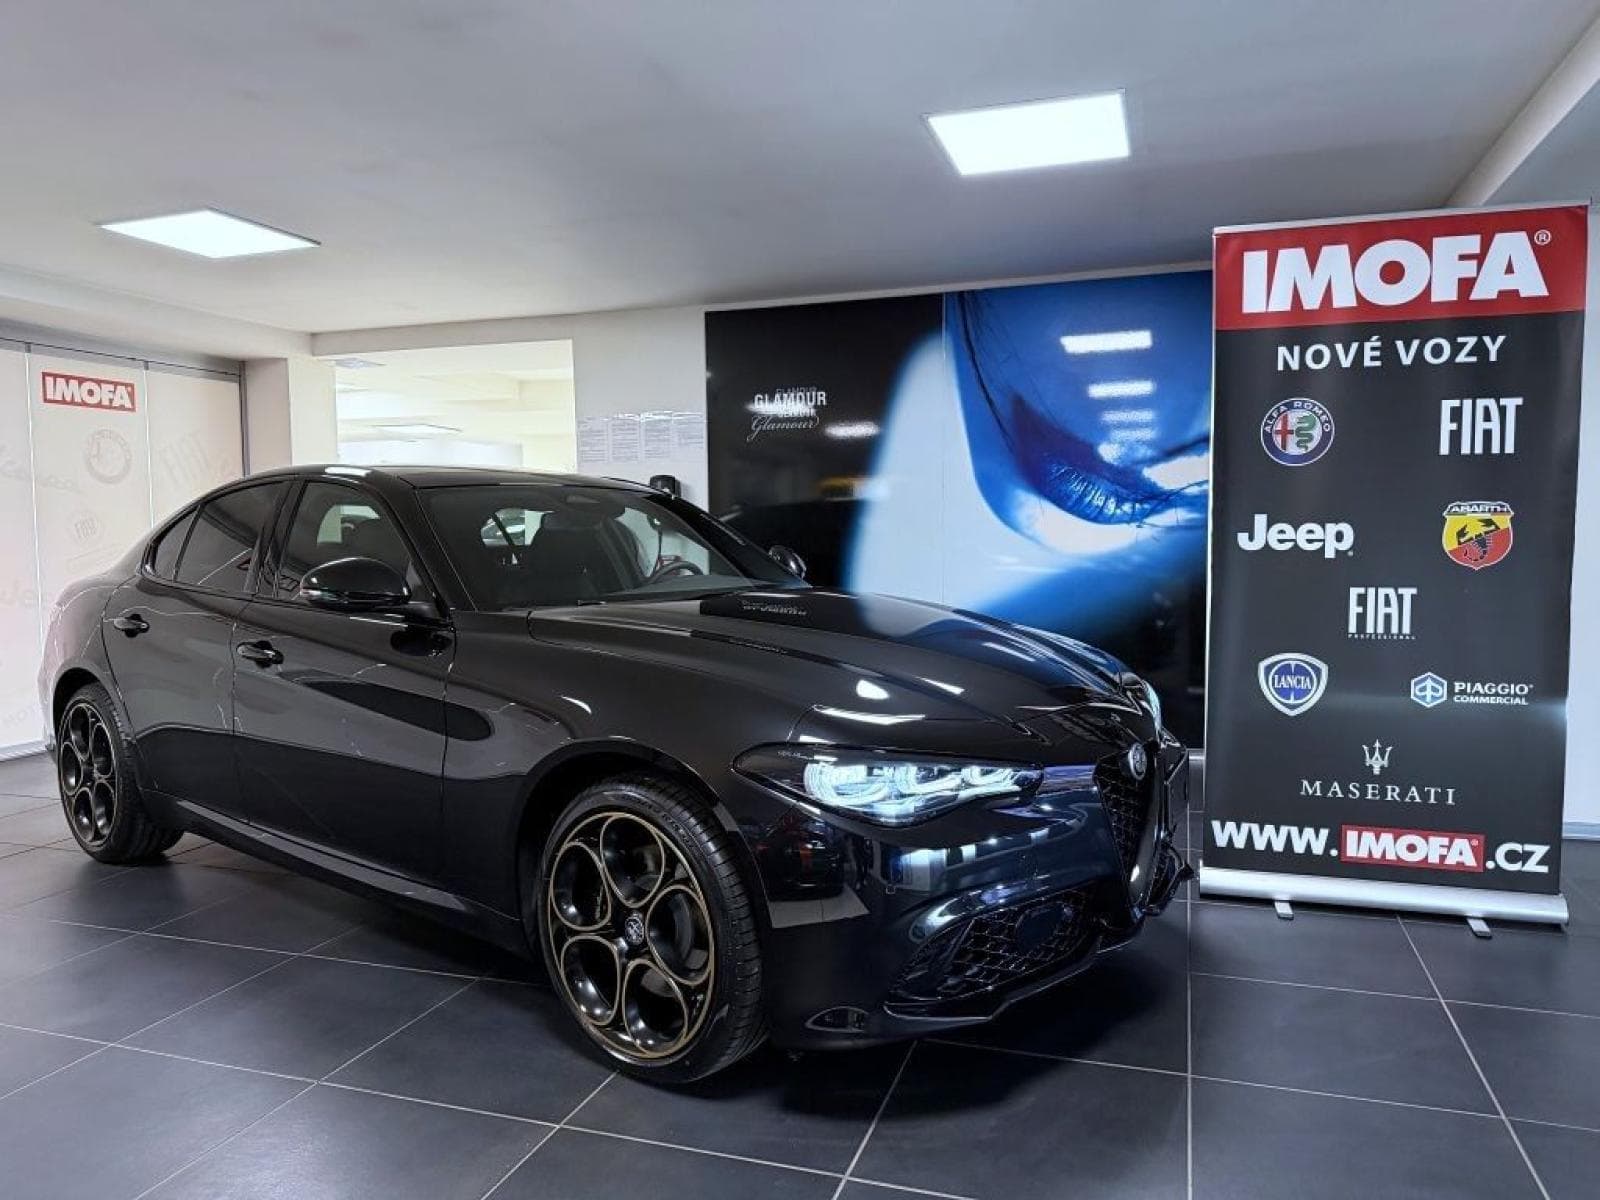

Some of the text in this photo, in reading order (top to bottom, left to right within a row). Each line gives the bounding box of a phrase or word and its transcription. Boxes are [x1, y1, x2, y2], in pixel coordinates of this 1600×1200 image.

[1277, 335, 1506, 371] NOVÉ VOZY
[1439, 397, 1523, 455] FIAT
[1237, 513, 1354, 558] Jeep
[1348, 586, 1418, 634] FIAT
[1273, 674, 1312, 690] LANCIA
[1453, 682, 1529, 695] PIAGGIO
[1453, 694, 1529, 705] COMMERCIAL
[1300, 779, 1456, 805] MASERATI
